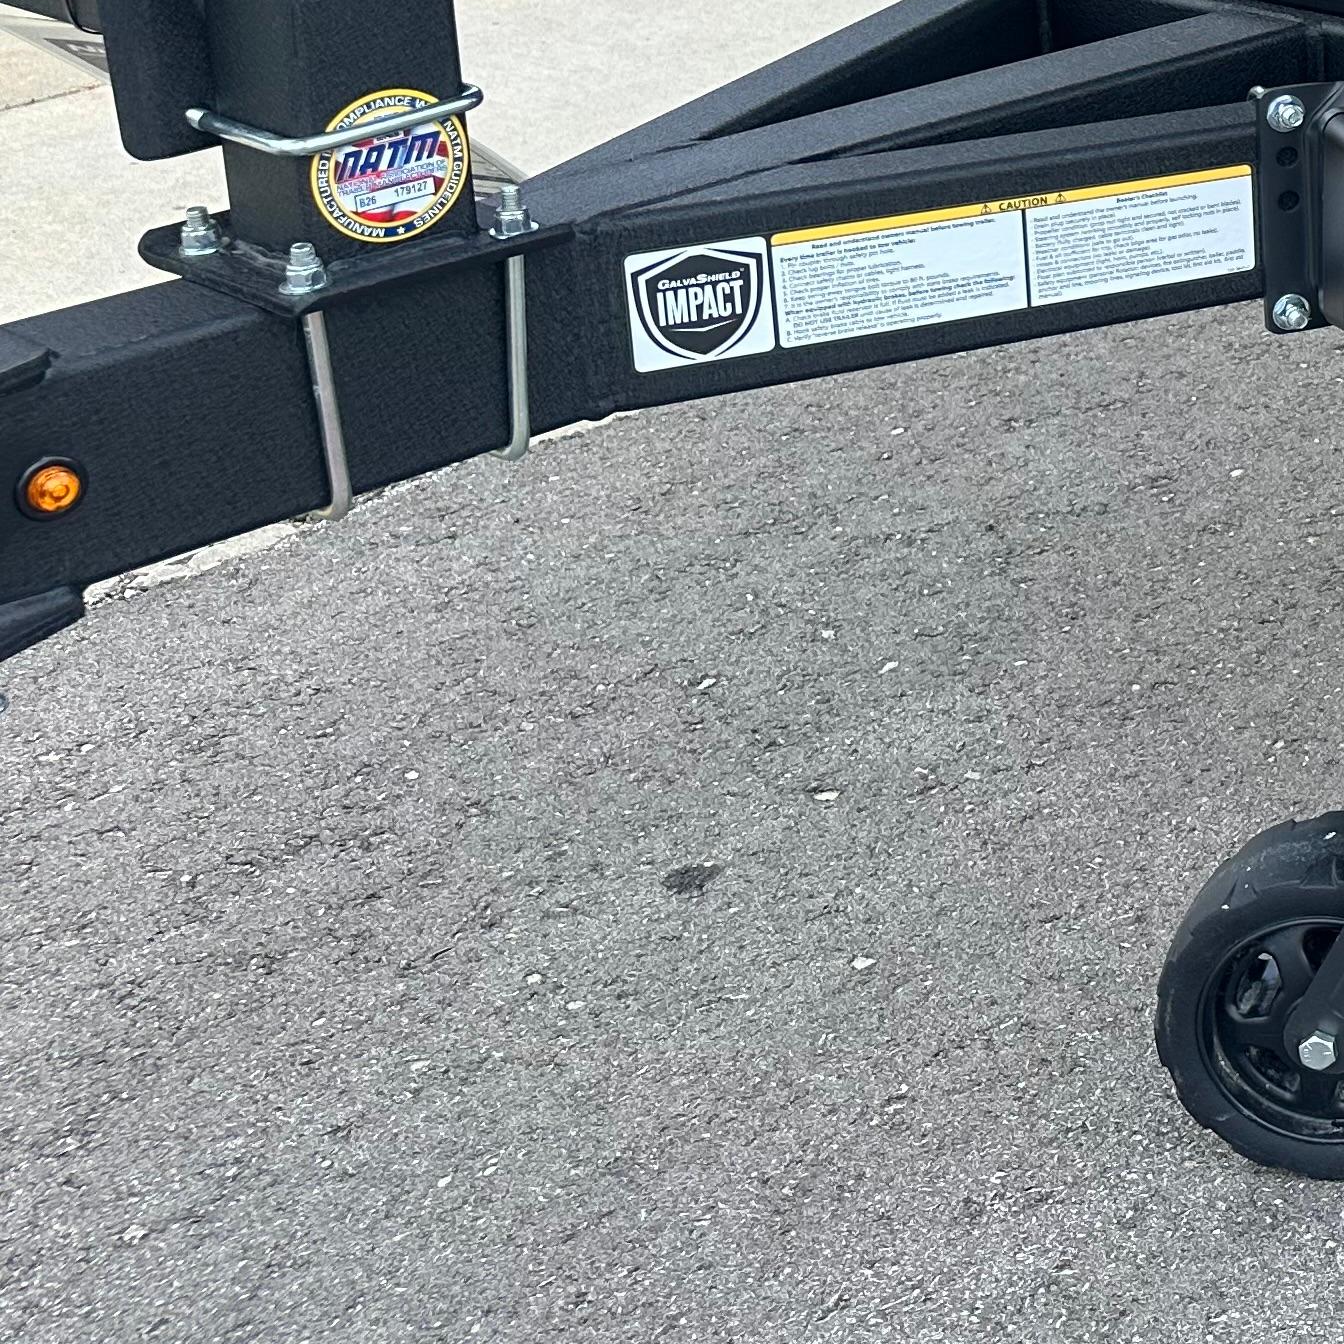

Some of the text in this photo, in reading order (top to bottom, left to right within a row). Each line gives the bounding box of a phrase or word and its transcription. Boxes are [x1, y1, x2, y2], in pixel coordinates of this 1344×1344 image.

[393, 180, 428, 198] 179127
[414, 120, 464, 228] NATM GUIDELINES
[319, 162, 386, 238] MANUFACTURED
[999, 197, 1047, 211] CAUTION
[656, 280, 744, 327] IMPACT
